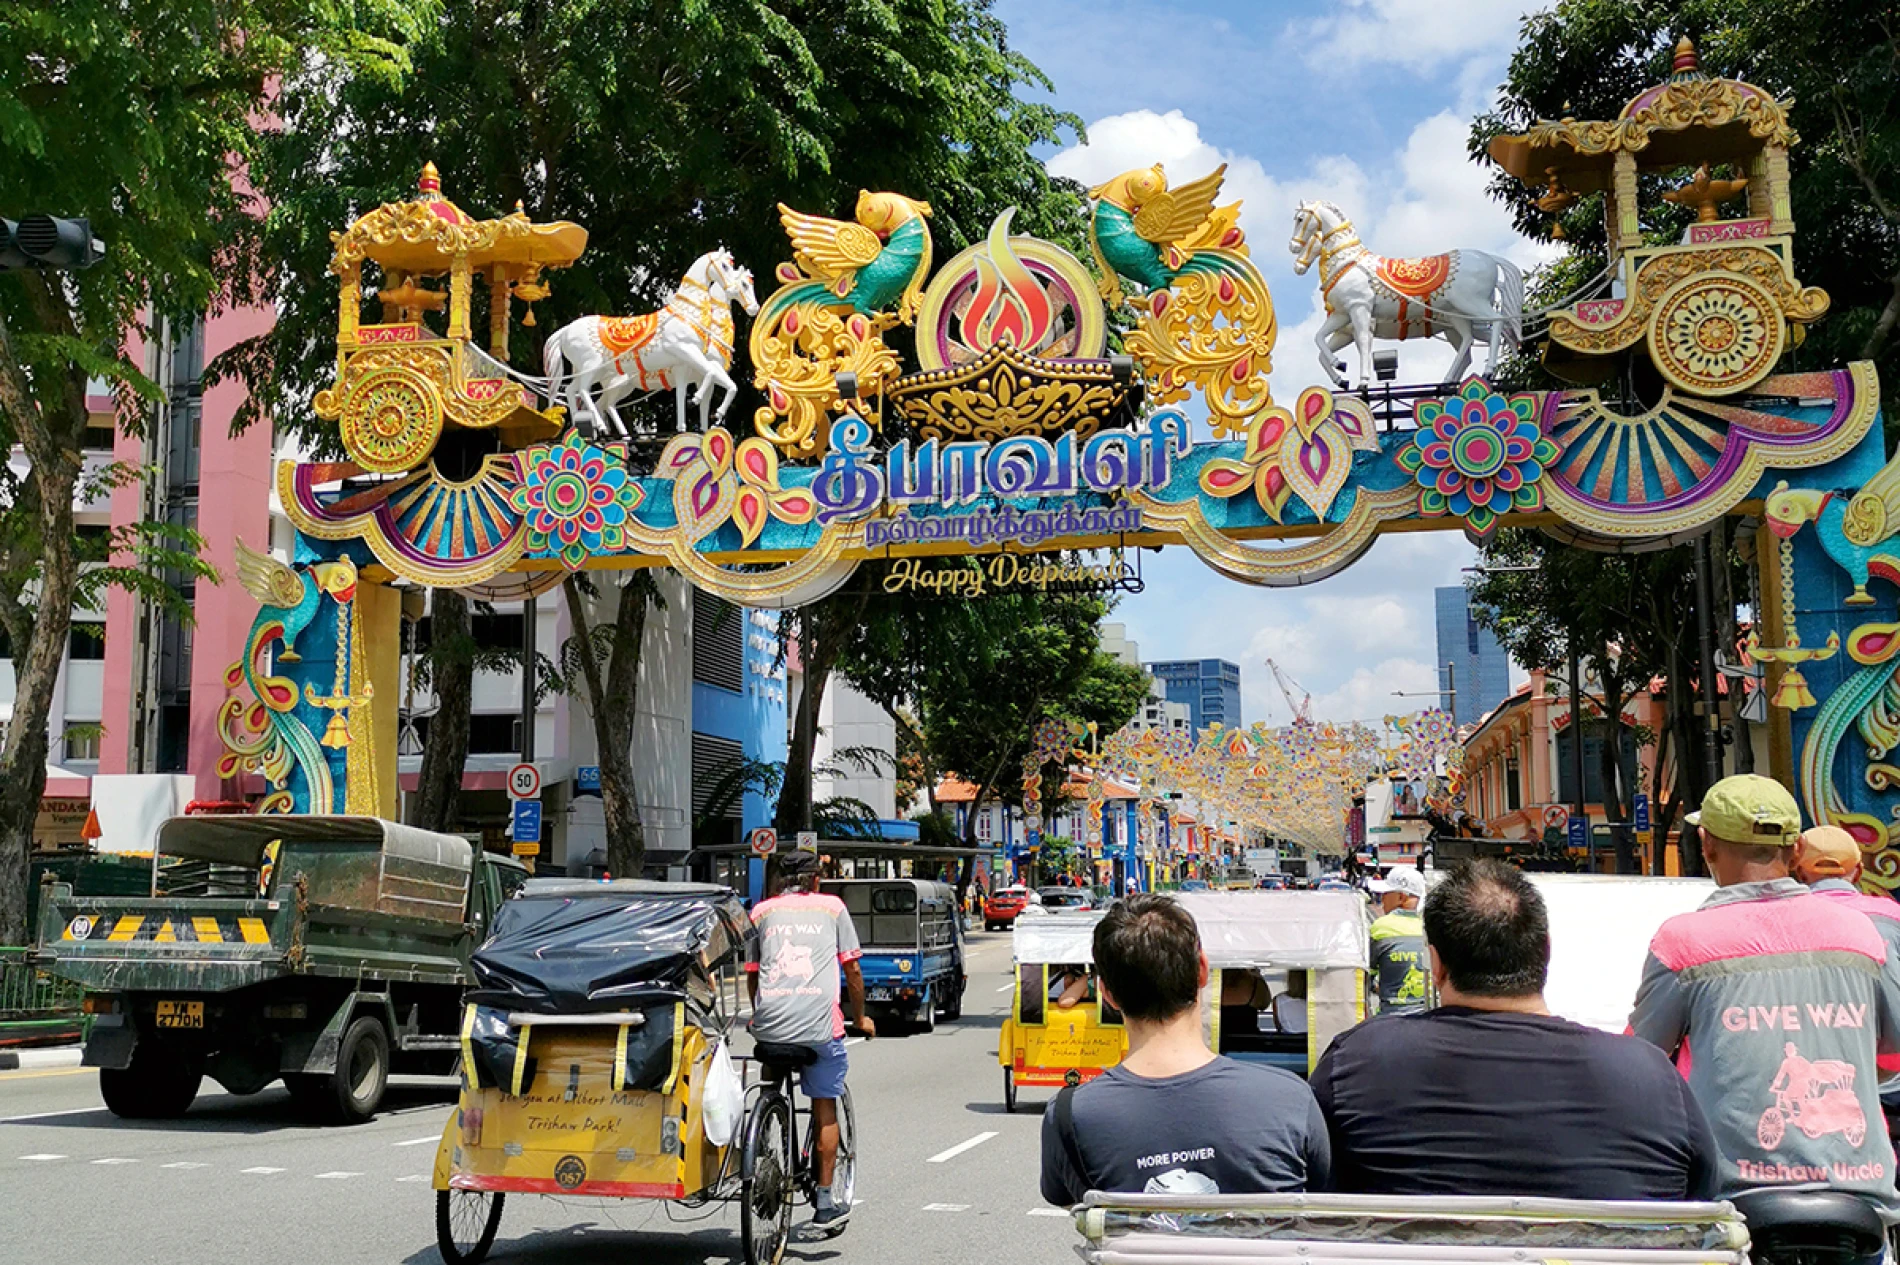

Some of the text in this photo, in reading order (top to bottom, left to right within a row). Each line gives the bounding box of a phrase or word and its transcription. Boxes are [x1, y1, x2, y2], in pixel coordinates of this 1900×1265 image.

[810, 408, 1193, 527] தீபாவளி
[864, 499, 1144, 549] நல்வாழ்த்துக்கள்
[883, 553, 1126, 598] Happy Deepavali
[517, 773, 532, 788] 50
[766, 924, 823, 937] GIVE WAY
[1390, 951, 1418, 962] GIVE
[158, 1014, 201, 1027] 2770H
[1722, 1002, 1867, 1032] GIVE WAY
[521, 1095, 543, 1108] you
[548, 1093, 561, 1103] at
[528, 1114, 576, 1131] Trishaw
[1136, 1147, 1215, 1169] MORE POWER
[559, 1172, 581, 1185] 057
[1736, 1159, 1885, 1181] Trishaw Uncle
